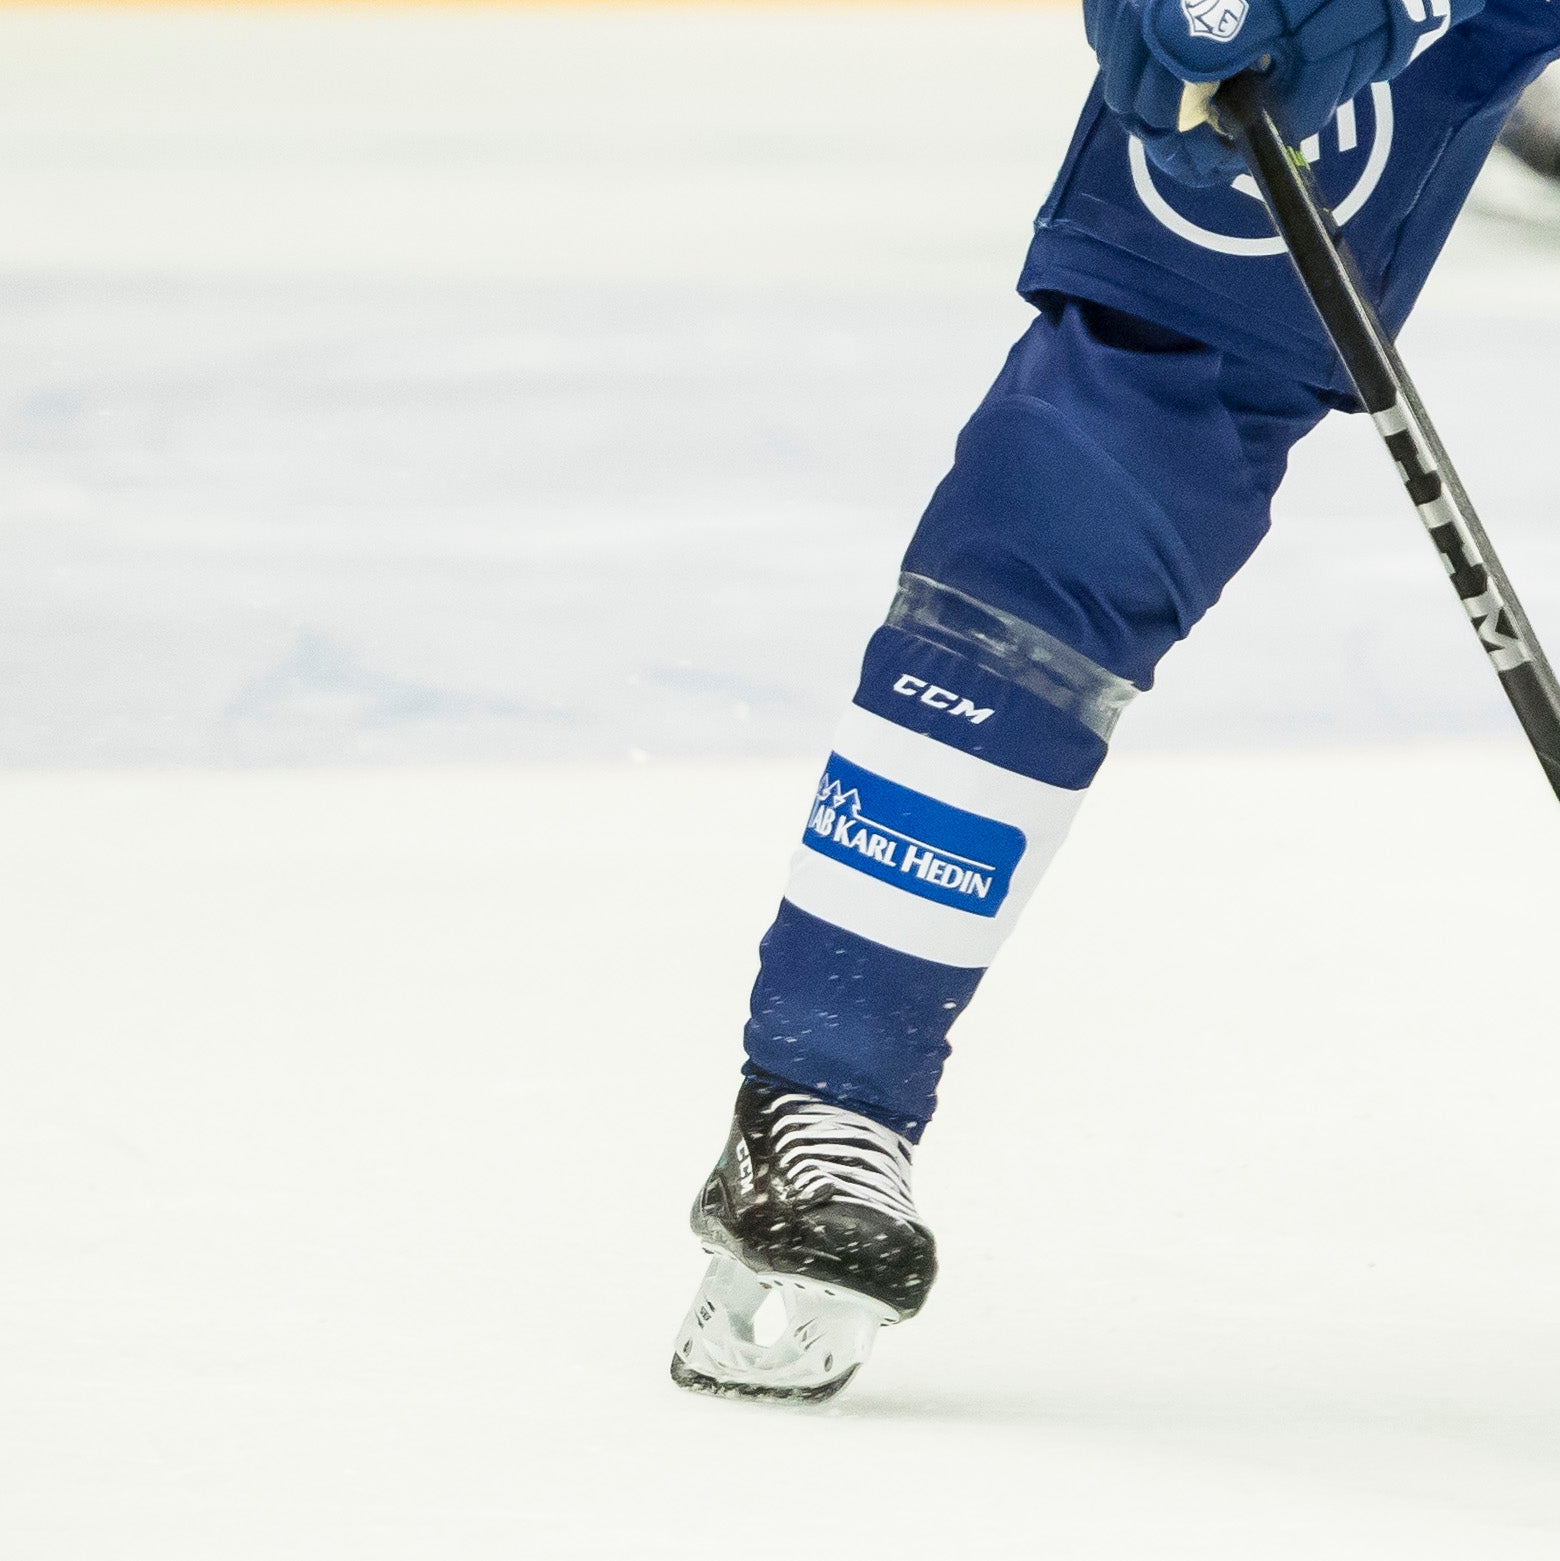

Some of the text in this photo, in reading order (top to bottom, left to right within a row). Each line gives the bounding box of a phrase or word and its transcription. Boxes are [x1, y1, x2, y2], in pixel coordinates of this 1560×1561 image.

[892, 672, 996, 726] CCM
[833, 818, 898, 869] KARL
[900, 843, 993, 900] HEDIN
